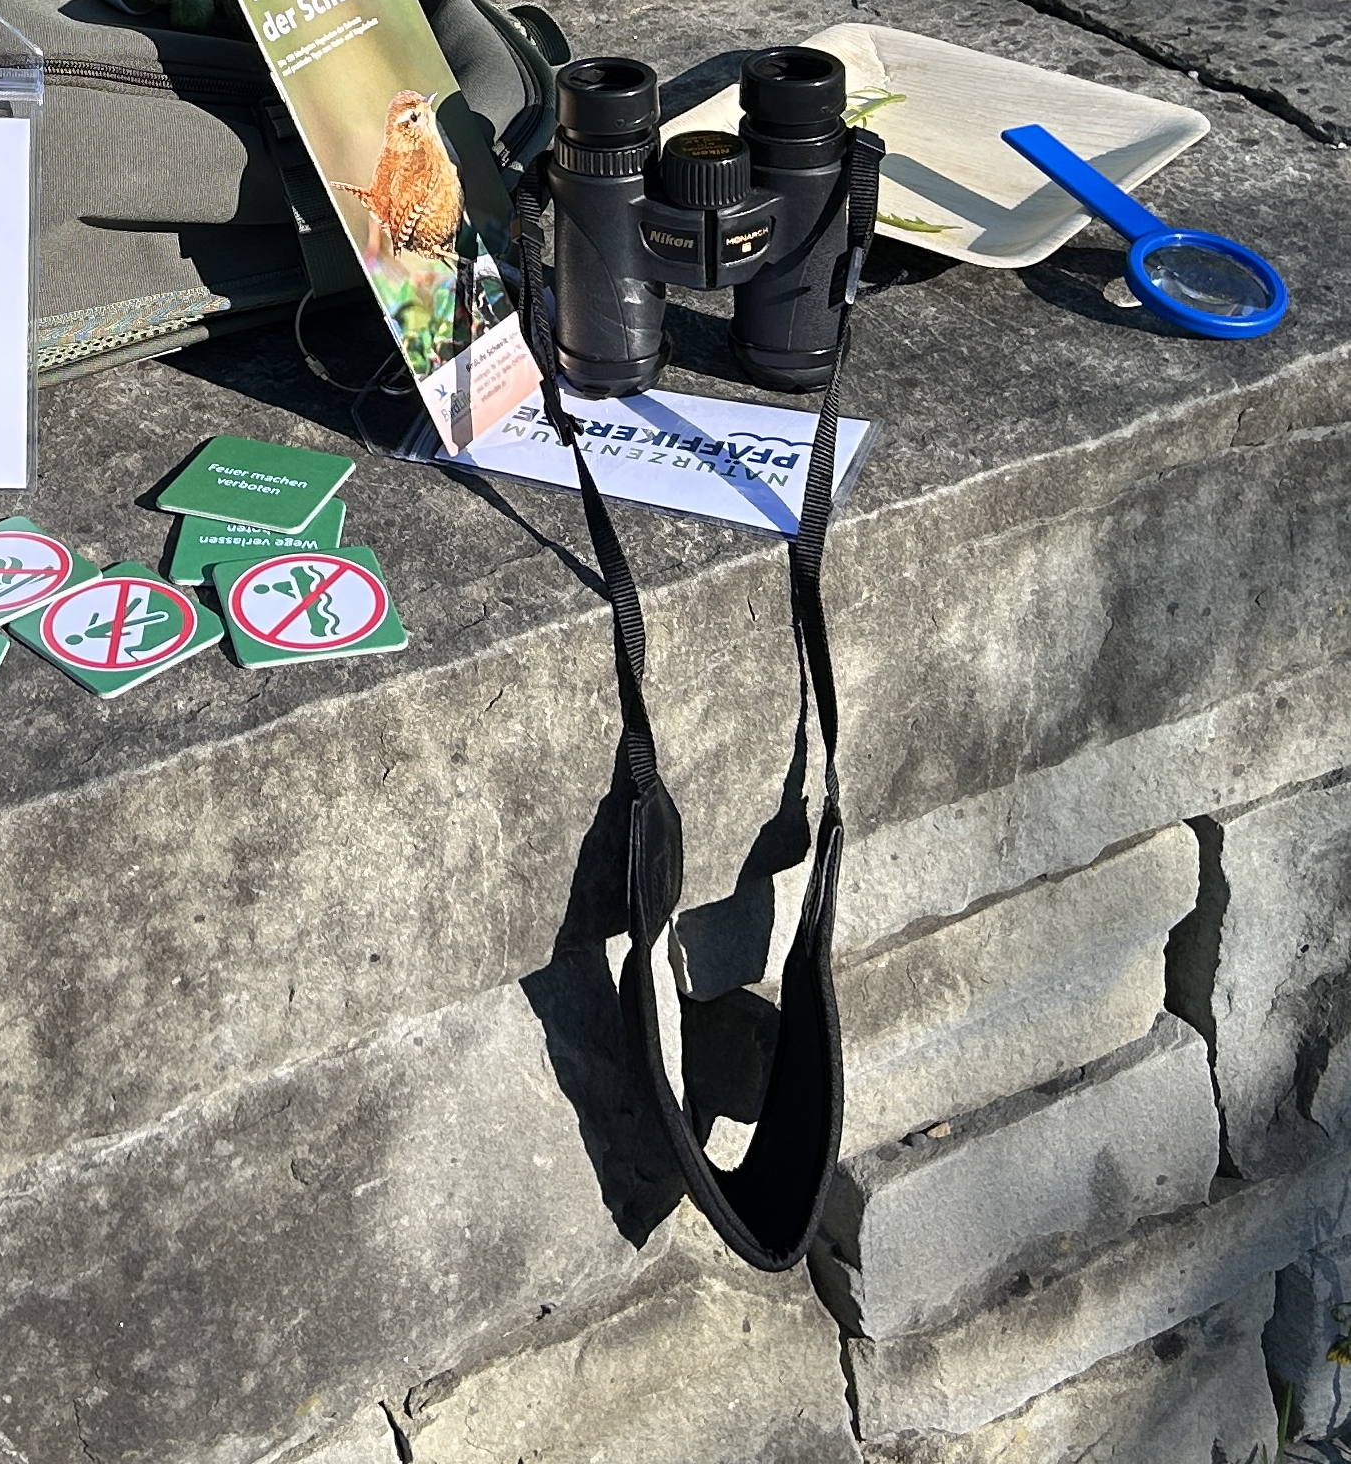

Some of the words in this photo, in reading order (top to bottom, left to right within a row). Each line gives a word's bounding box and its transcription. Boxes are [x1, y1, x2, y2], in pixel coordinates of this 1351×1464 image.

[262, 7, 298, 43] der
[650, 230, 695, 249] Nikon
[726, 226, 769, 246] MONARCH
[512, 404, 800, 470] PFÄFFIKERE
[207, 462, 250, 478] Feuer
[251, 470, 308, 489] machen
[216, 476, 282, 496] verboten
[199, 534, 271, 548] verlassen
[275, 538, 319, 550] Wege
